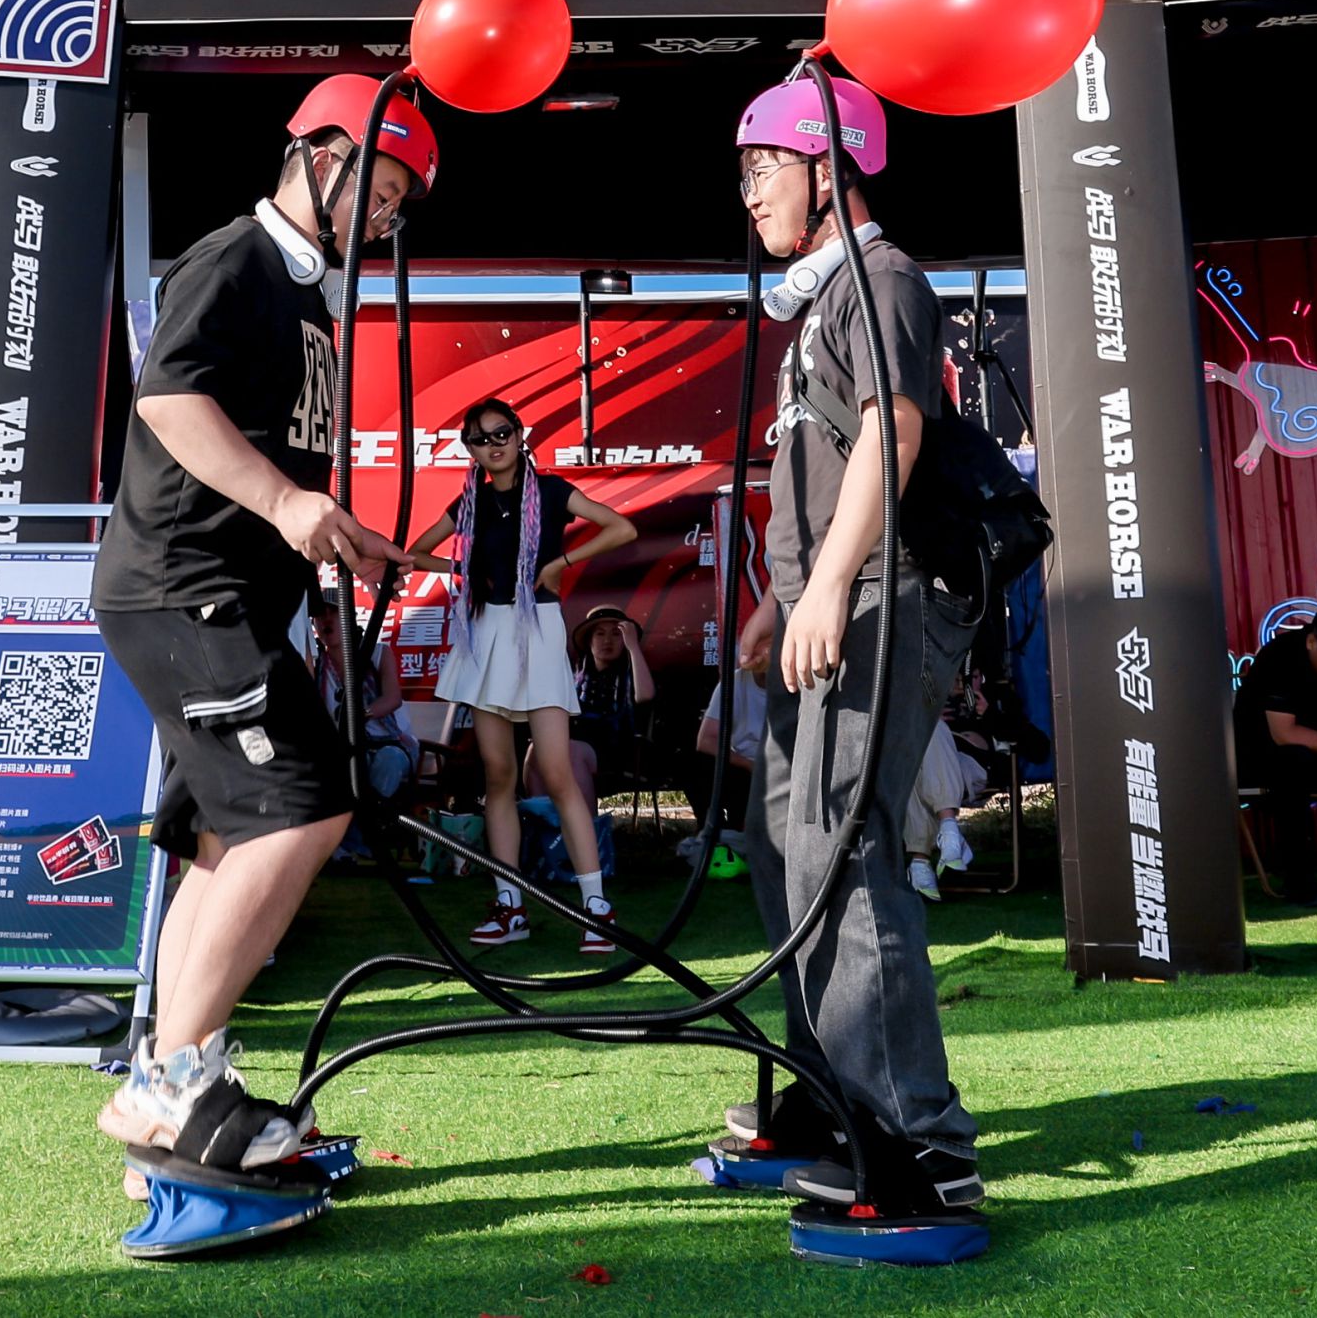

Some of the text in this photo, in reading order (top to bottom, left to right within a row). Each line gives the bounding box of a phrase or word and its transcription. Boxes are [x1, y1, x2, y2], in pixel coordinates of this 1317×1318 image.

[33, 89, 46, 126] HORSE
[1084, 52, 1099, 115] WAR HORSE
[13, 194, 44, 252] 战马
[1084, 185, 1119, 242] 战马
[2, 252, 40, 373] 敢玩时刻
[1088, 243, 1128, 364] 敢玩时刻
[1098, 387, 1136, 469] WAR
[1104, 471, 1144, 600] HORSE
[1123, 738, 1162, 835] 有能量
[1129, 831, 1172, 964] 当燃战马
